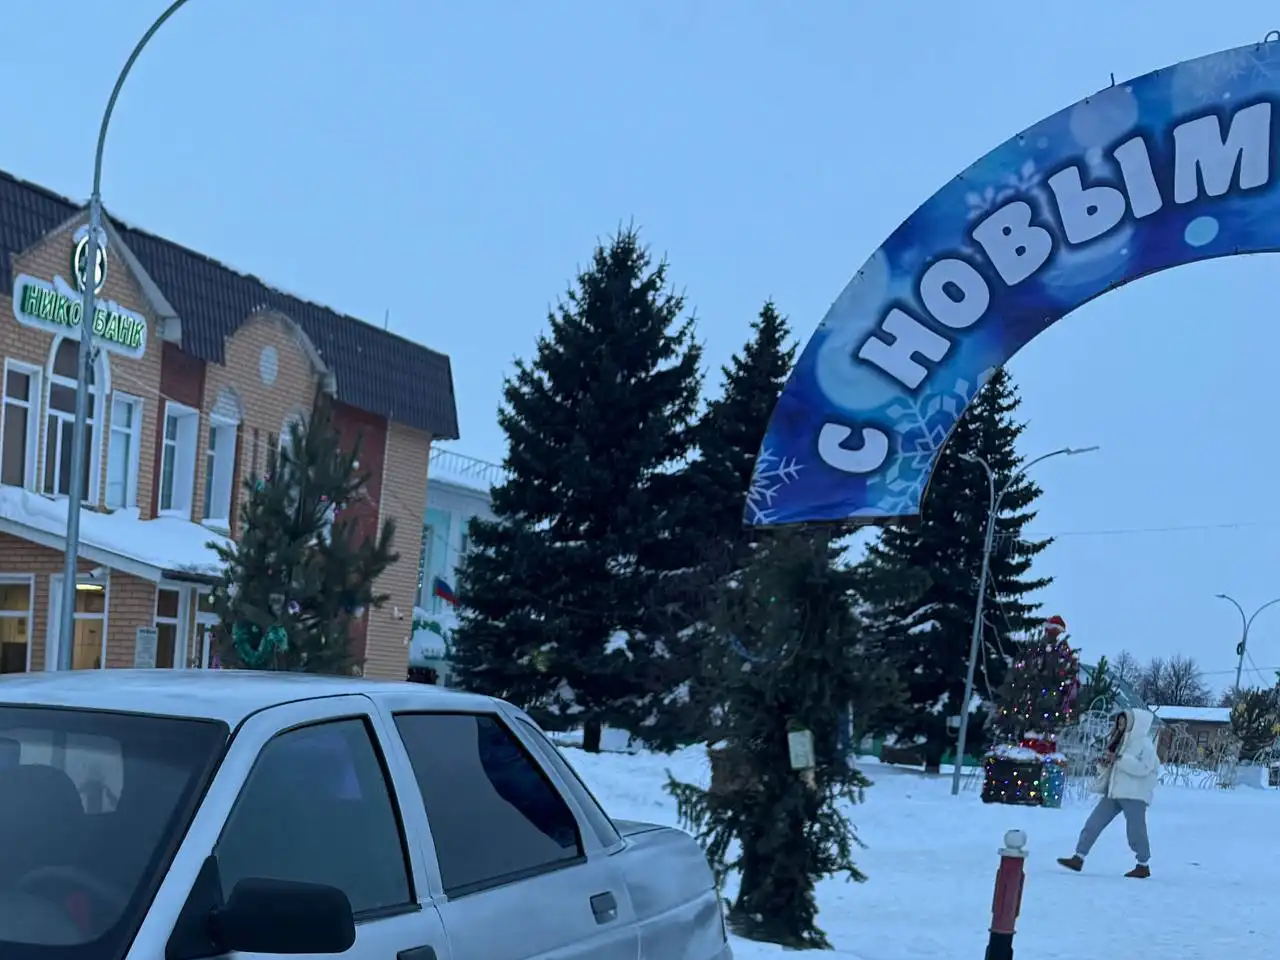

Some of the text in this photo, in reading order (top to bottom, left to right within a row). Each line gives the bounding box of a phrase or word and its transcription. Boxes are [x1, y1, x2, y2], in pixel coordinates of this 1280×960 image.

[24, 283, 145, 348] НИКО БАНК
[818, 102, 1272, 473] С НОВЫМ
